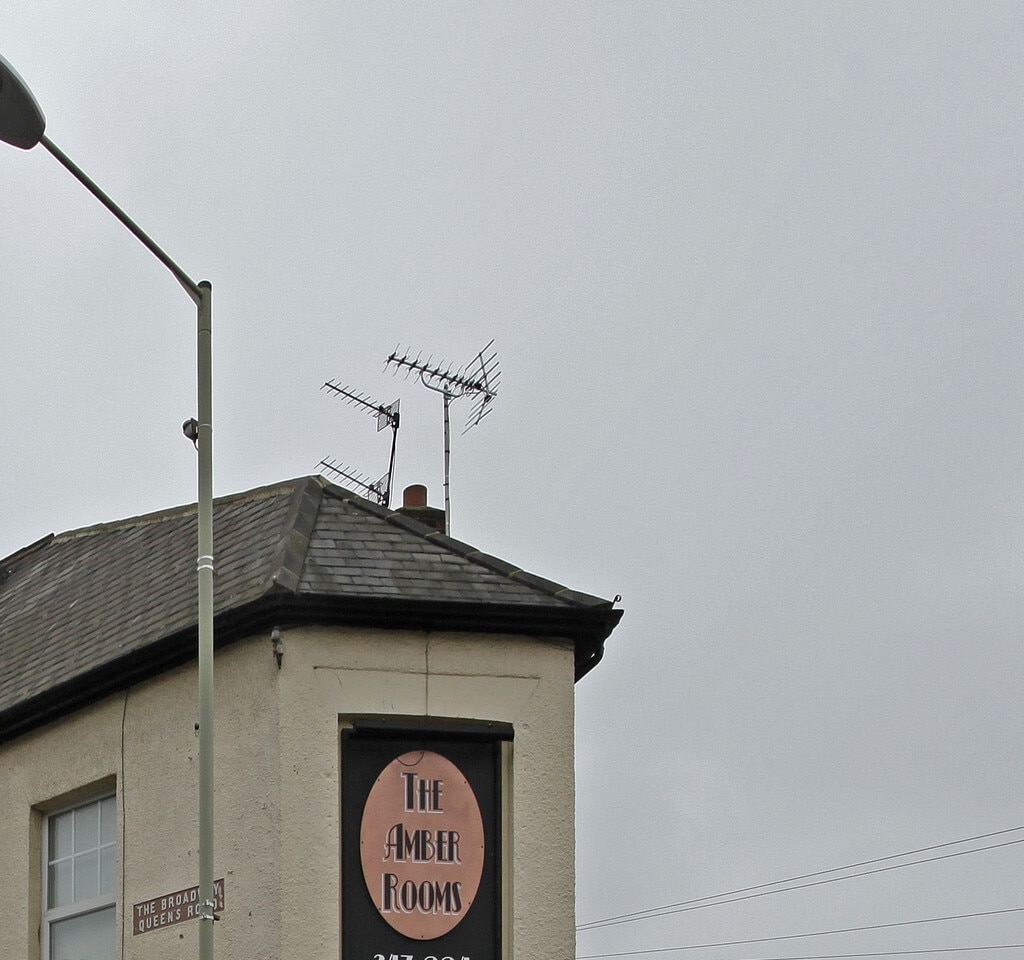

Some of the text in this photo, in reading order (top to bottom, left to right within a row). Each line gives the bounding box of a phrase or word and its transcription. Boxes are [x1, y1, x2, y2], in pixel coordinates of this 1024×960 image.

[400, 772, 444, 814] THE
[382, 823, 462, 865] AMBER
[136, 901, 156, 917] THE
[161, 883, 219, 911] BROADY
[381, 873, 463, 915] ROOMS
[139, 909, 181, 932] QUEEN'S
